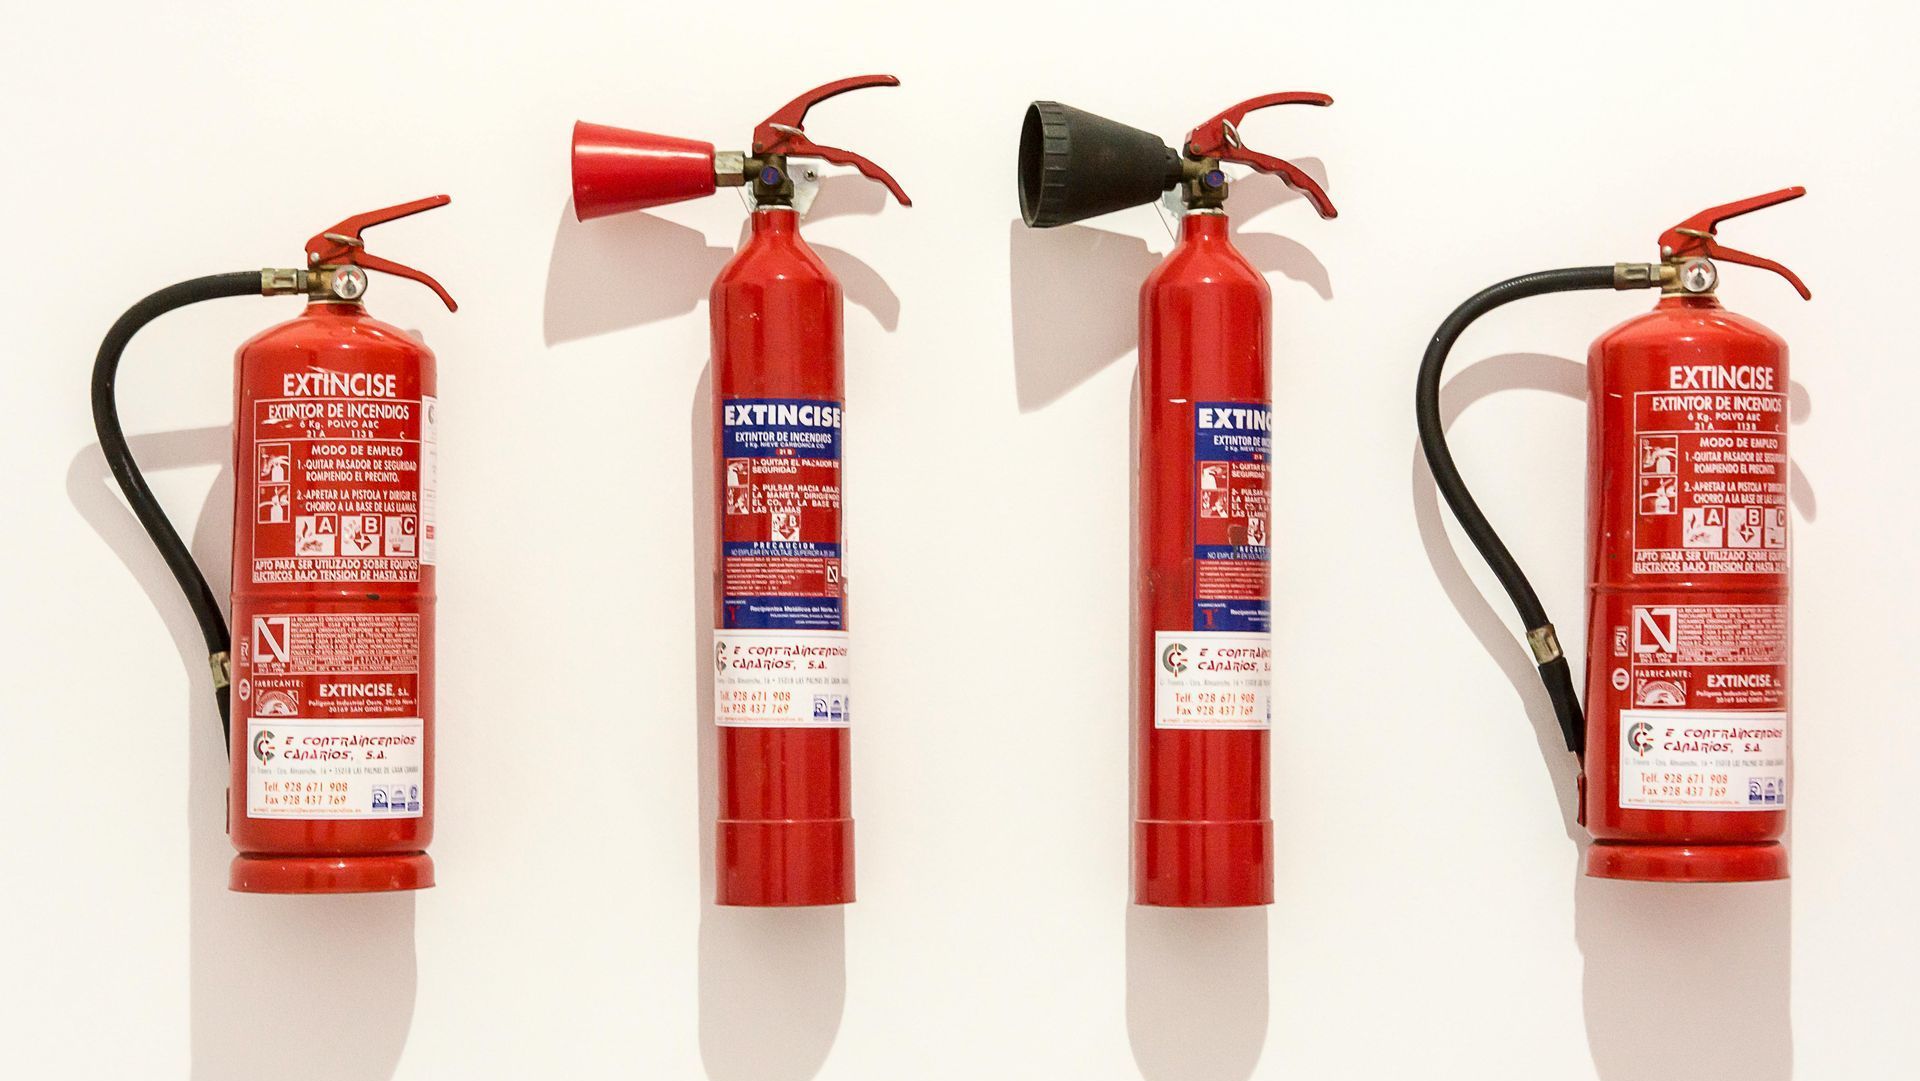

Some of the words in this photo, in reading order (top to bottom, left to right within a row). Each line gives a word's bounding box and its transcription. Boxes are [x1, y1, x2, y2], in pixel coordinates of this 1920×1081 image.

[1670, 365, 1773, 390] EXTINCISE
[283, 373, 396, 397] EXTINCISE
[1652, 396, 1713, 411] EXTINTOR
[1715, 396, 1732, 411] DE
[1734, 396, 1782, 412] INCENDIOS
[269, 403, 324, 419] EXTINTOR
[328, 403, 344, 418] DE
[347, 403, 410, 420] INCENDIOS
[724, 404, 841, 428] EXTINCISE
[1715, 412, 1744, 420] POLVO
[327, 420, 359, 428] POLVO
[735, 432, 775, 442] EXTINTOR
[776, 432, 788, 441] DE
[790, 432, 832, 443] INCENDIOS
[1213, 435, 1252, 446] EXTINTOR
[1699, 437, 1734, 448] MODO
[1736, 438, 1749, 448] DE
[1751, 438, 1778, 449] EMPLEO
[311, 445, 347, 455] MODO
[350, 445, 364, 455] DE
[367, 446, 403, 456] EMPLEO
[1723, 452, 1754, 462] PASADOR
[336, 460, 371, 470] PASADOR
[373, 461, 382, 470] DE
[752, 466, 797, 474] SEGURIDAD
[1694, 463, 1739, 474] ROMPIENDO
[306, 471, 352, 481] ROMPIENDO
[355, 472, 363, 481] EL
[1727, 481, 1737, 492] LA
[340, 489, 350, 499] LA
[352, 489, 381, 500] PISTOLA
[383, 490, 388, 500] Y
[1693, 493, 1724, 504] CHORRO
[1725, 493, 1731, 503] A
[1731, 494, 1740, 504] LA
[305, 501, 336, 512] CHORRO
[338, 502, 344, 511] A
[345, 502, 354, 512] LA
[356, 502, 373, 512] BASE
[374, 502, 382, 512] DE
[384, 502, 395, 512] LAS
[1706, 508, 1721, 525] A
[1748, 509, 1760, 525] B
[318, 517, 333, 533] A
[365, 517, 378, 533] B
[403, 517, 414, 534] C
[1636, 551, 1658, 561] APTO
[1660, 551, 1683, 561] PARA
[1685, 551, 1701, 561] SER
[1703, 551, 1745, 561] UTILIZADO
[255, 560, 273, 570] APTO
[275, 560, 295, 569] PARA
[298, 560, 313, 569] SER
[315, 560, 361, 569] UTILIZADO
[363, 560, 388, 569] SOBRE
[1682, 562, 1705, 572] BAJO
[1708, 562, 1744, 572] TENSION
[295, 570, 318, 580] BAJO
[320, 570, 358, 580] TENSION
[360, 570, 371, 580] DE
[733, 691, 747, 701] 928
[751, 692, 767, 701] 671
[772, 691, 791, 701] 908
[1198, 693, 1216, 703] 928
[1220, 693, 1236, 703] 671
[1241, 693, 1255, 703] 908
[732, 703, 746, 713] 928
[771, 704, 789, 713] 769
[1176, 705, 1191, 715] Fax
[1197, 705, 1214, 715] 928
[1219, 706, 1235, 715] 437
[1664, 773, 1682, 783] 928
[1687, 774, 1704, 783] 671
[1710, 774, 1728, 784] 908
[284, 782, 301, 792] 928
[306, 782, 323, 792] 671
[329, 782, 348, 792] 908
[1641, 786, 1657, 796] Fax
[1662, 786, 1680, 796] 928
[1685, 787, 1703, 796] 437
[1709, 787, 1726, 797] 769
[265, 794, 278, 804] Fax
[283, 795, 300, 805] 928
[305, 795, 322, 805] 437
[328, 795, 346, 805] 769
